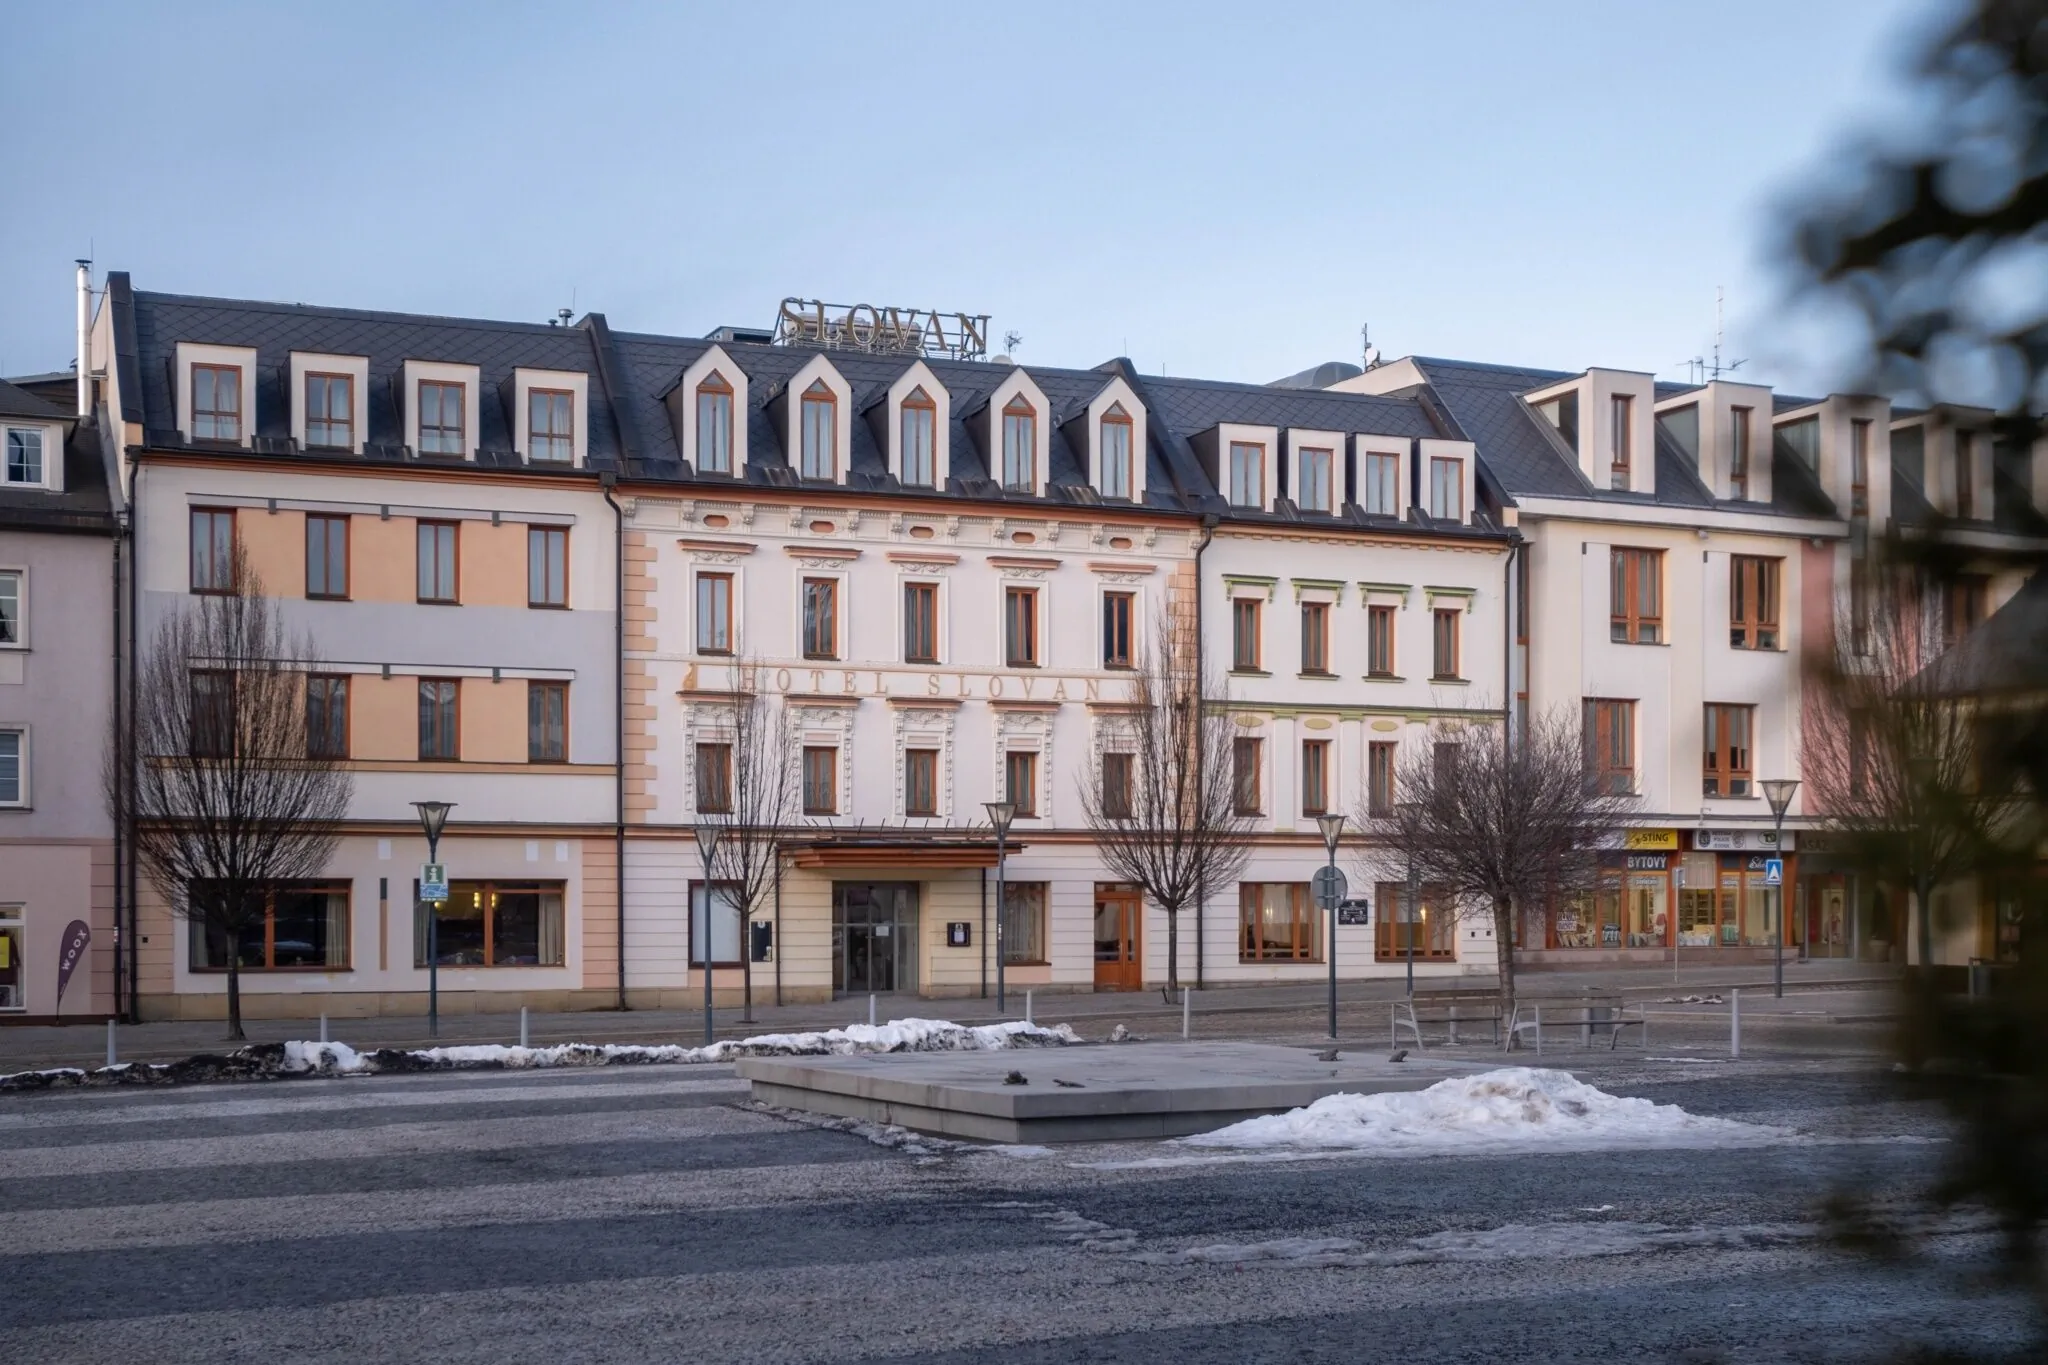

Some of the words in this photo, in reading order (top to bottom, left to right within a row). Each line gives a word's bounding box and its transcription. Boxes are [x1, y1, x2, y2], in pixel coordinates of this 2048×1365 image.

[780, 296, 992, 354] SLOVAN
[740, 668, 889, 694] HOTEL
[927, 673, 1101, 701] SLOVAN
[1641, 833, 1669, 842] STING
[1627, 852, 1667, 869] BYTOVÝ
[61, 928, 87, 971] WOOX
